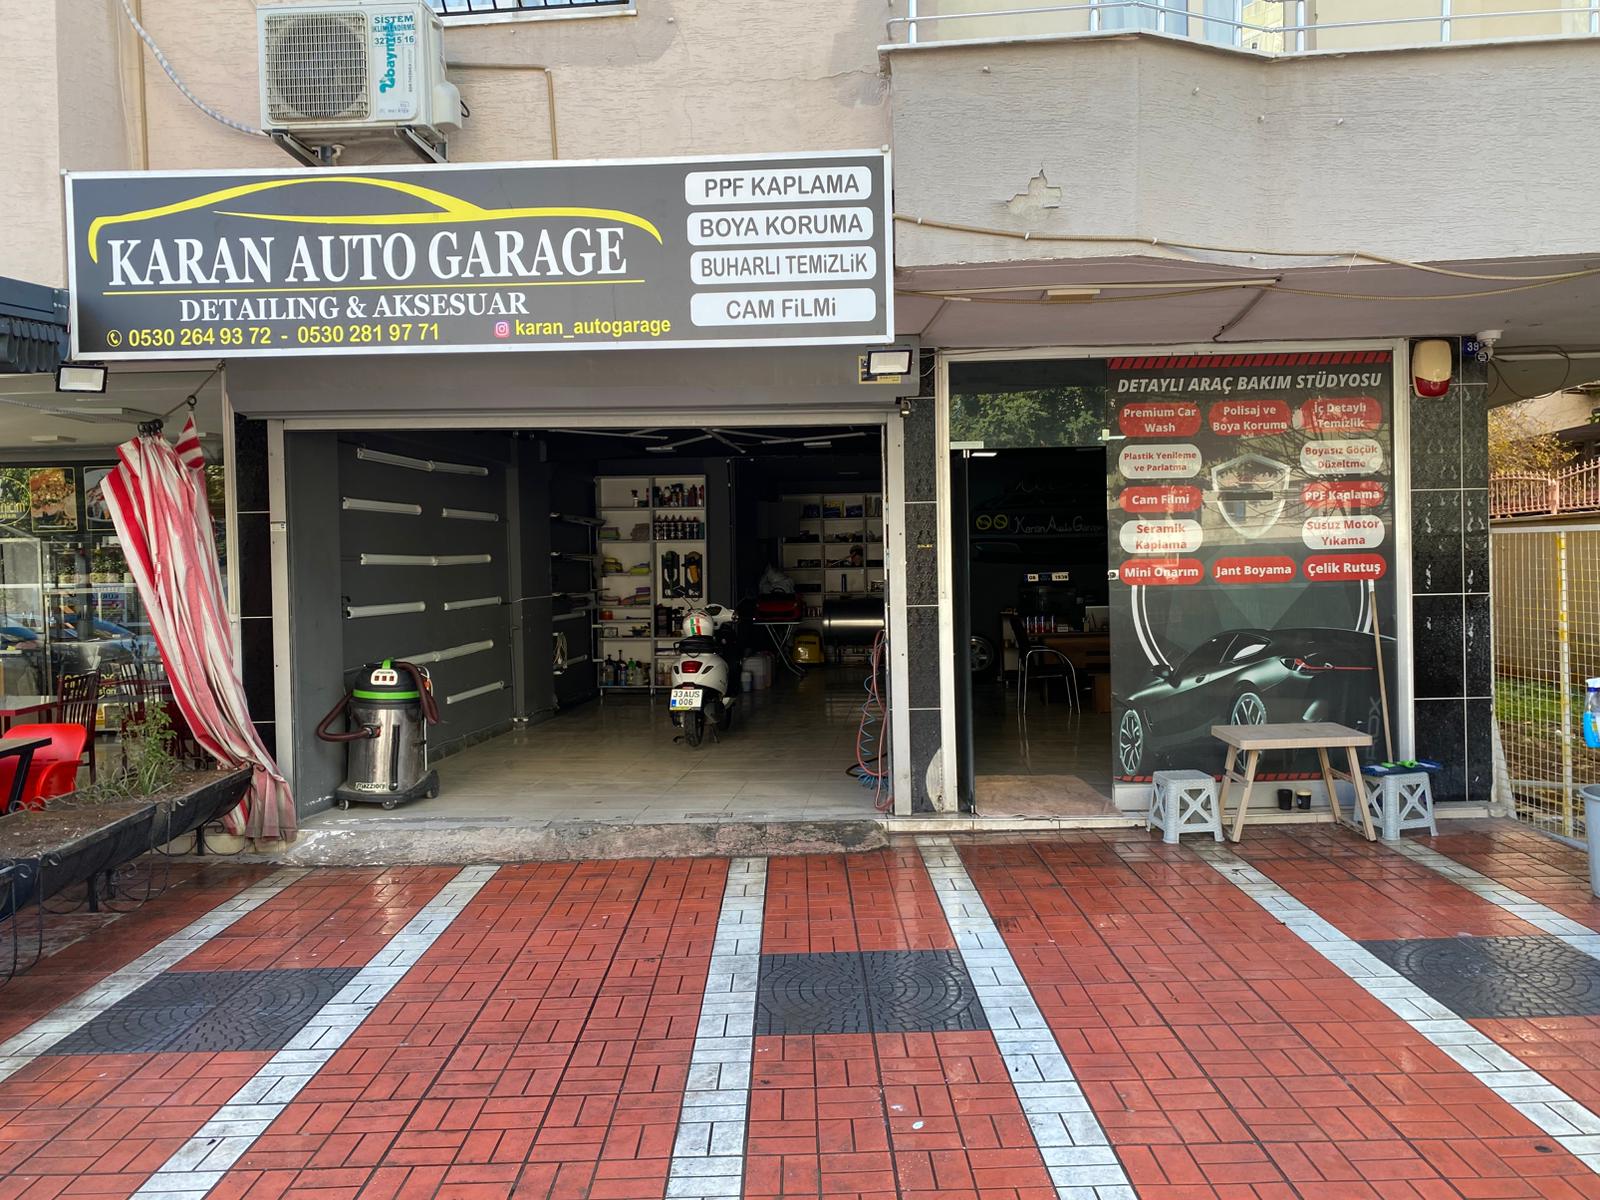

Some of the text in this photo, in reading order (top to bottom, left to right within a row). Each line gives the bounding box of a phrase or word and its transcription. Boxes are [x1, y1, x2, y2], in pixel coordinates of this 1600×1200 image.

[704, 174, 859, 198] PPF KAPLAMA
[700, 213, 862, 239] BOYA KORUMA
[107, 227, 627, 286] KARAN AUTO GARAGE
[701, 255, 781, 277] BUHARLI
[179, 292, 529, 323] DETAILING & AKSESUAR
[726, 298, 775, 319] CAM
[128, 327, 174, 346] 0530
[180, 326, 215, 346] 264
[220, 326, 244, 345] 93
[249, 325, 271, 344] 72
[297, 325, 344, 344] 0530
[349, 323, 382, 343] 281
[389, 323, 412, 342] 97
[417, 322, 439, 341] 71
[515, 317, 671, 340] karan_autogarage
[1118, 370, 1382, 394] DETAYLI ARAÇ BAKIM STÜDYOSU
[1123, 407, 1197, 418] Premium Car
[1223, 405, 1277, 417] Polisaj ve
[1326, 402, 1367, 415] Detaylı
[1144, 421, 1176, 433] Wash
[1213, 420, 1288, 433] Boya Koruma
[1317, 416, 1364, 429] Temizlik
[1123, 450, 1197, 460] Plastik Yenileme
[1305, 444, 1378, 458] Boyasız Göçük
[1134, 462, 1187, 472] ve Parlatma
[1317, 457, 1367, 469] Düzeltme
[1132, 493, 1190, 505] Cam Filmi
[1305, 489, 1380, 503] PPF Kaplama
[1136, 523, 1186, 535] Seramik
[1307, 519, 1380, 531] Susuz Motor
[1135, 538, 1187, 552] Kaplama
[1322, 534, 1366, 546] Yıkama
[1124, 566, 1199, 578] Mini Onarım
[1215, 564, 1292, 578] Jant Boyama
[1307, 561, 1381, 576] Çelik Rutuş
